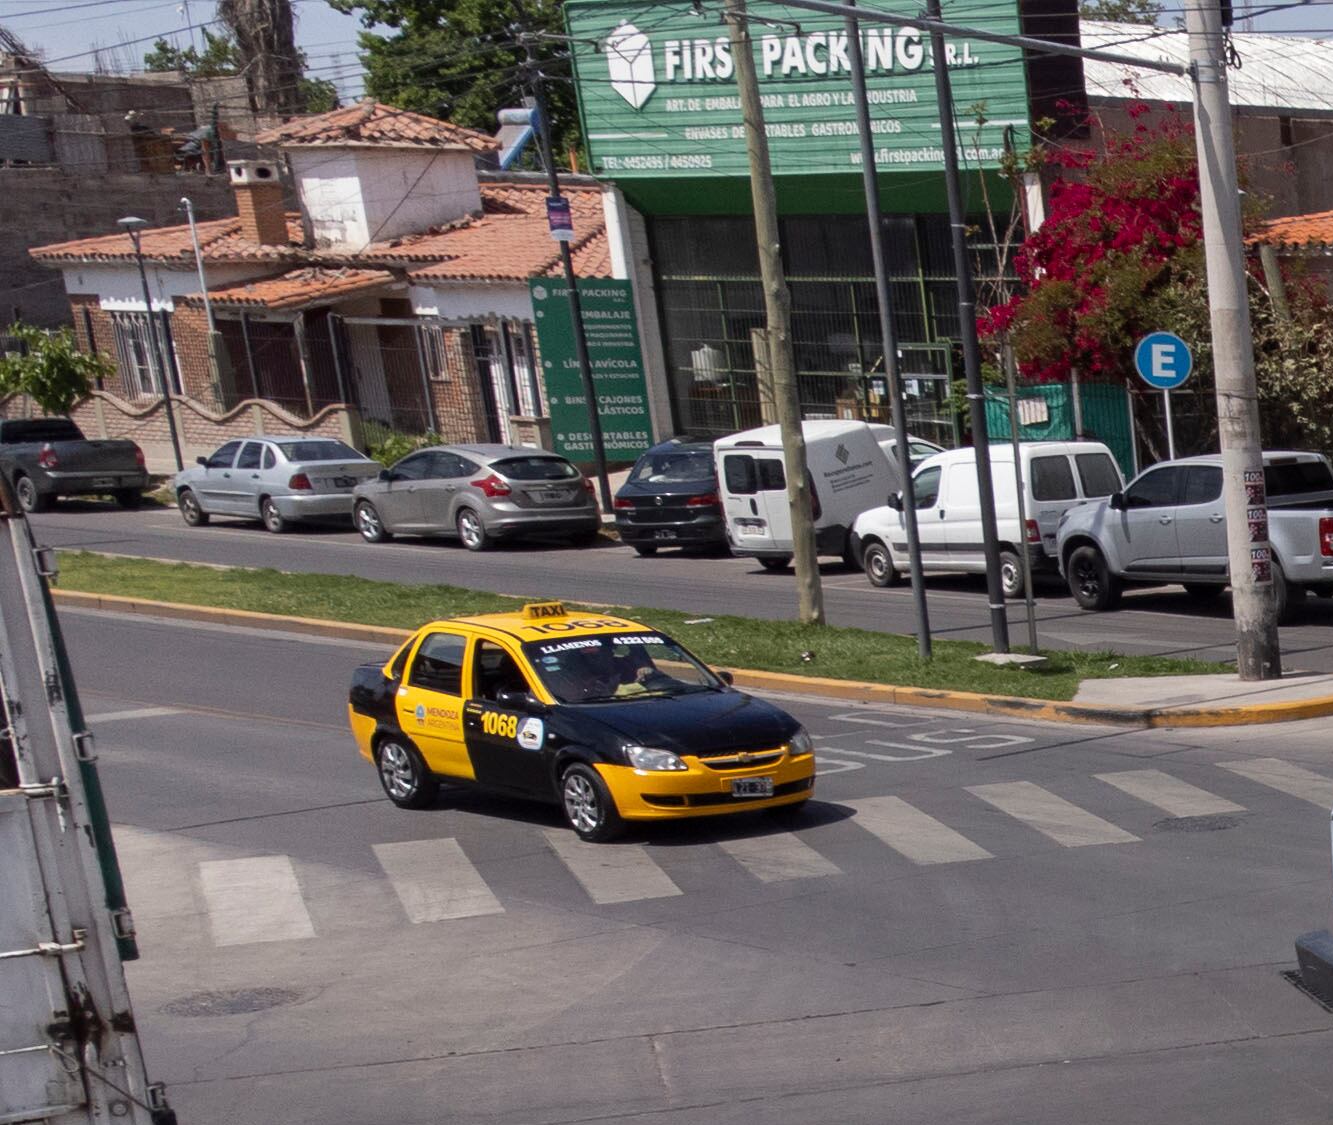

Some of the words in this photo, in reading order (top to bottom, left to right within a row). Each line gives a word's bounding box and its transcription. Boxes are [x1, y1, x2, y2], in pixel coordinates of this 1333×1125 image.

[664, 37, 734, 80] FIRS
[803, 91, 830, 105] AGRO
[1150, 343, 1177, 378] E
[598, 405, 645, 415] LÁSTICOS
[529, 605, 567, 618] TAXI
[481, 710, 518, 739] 1068
